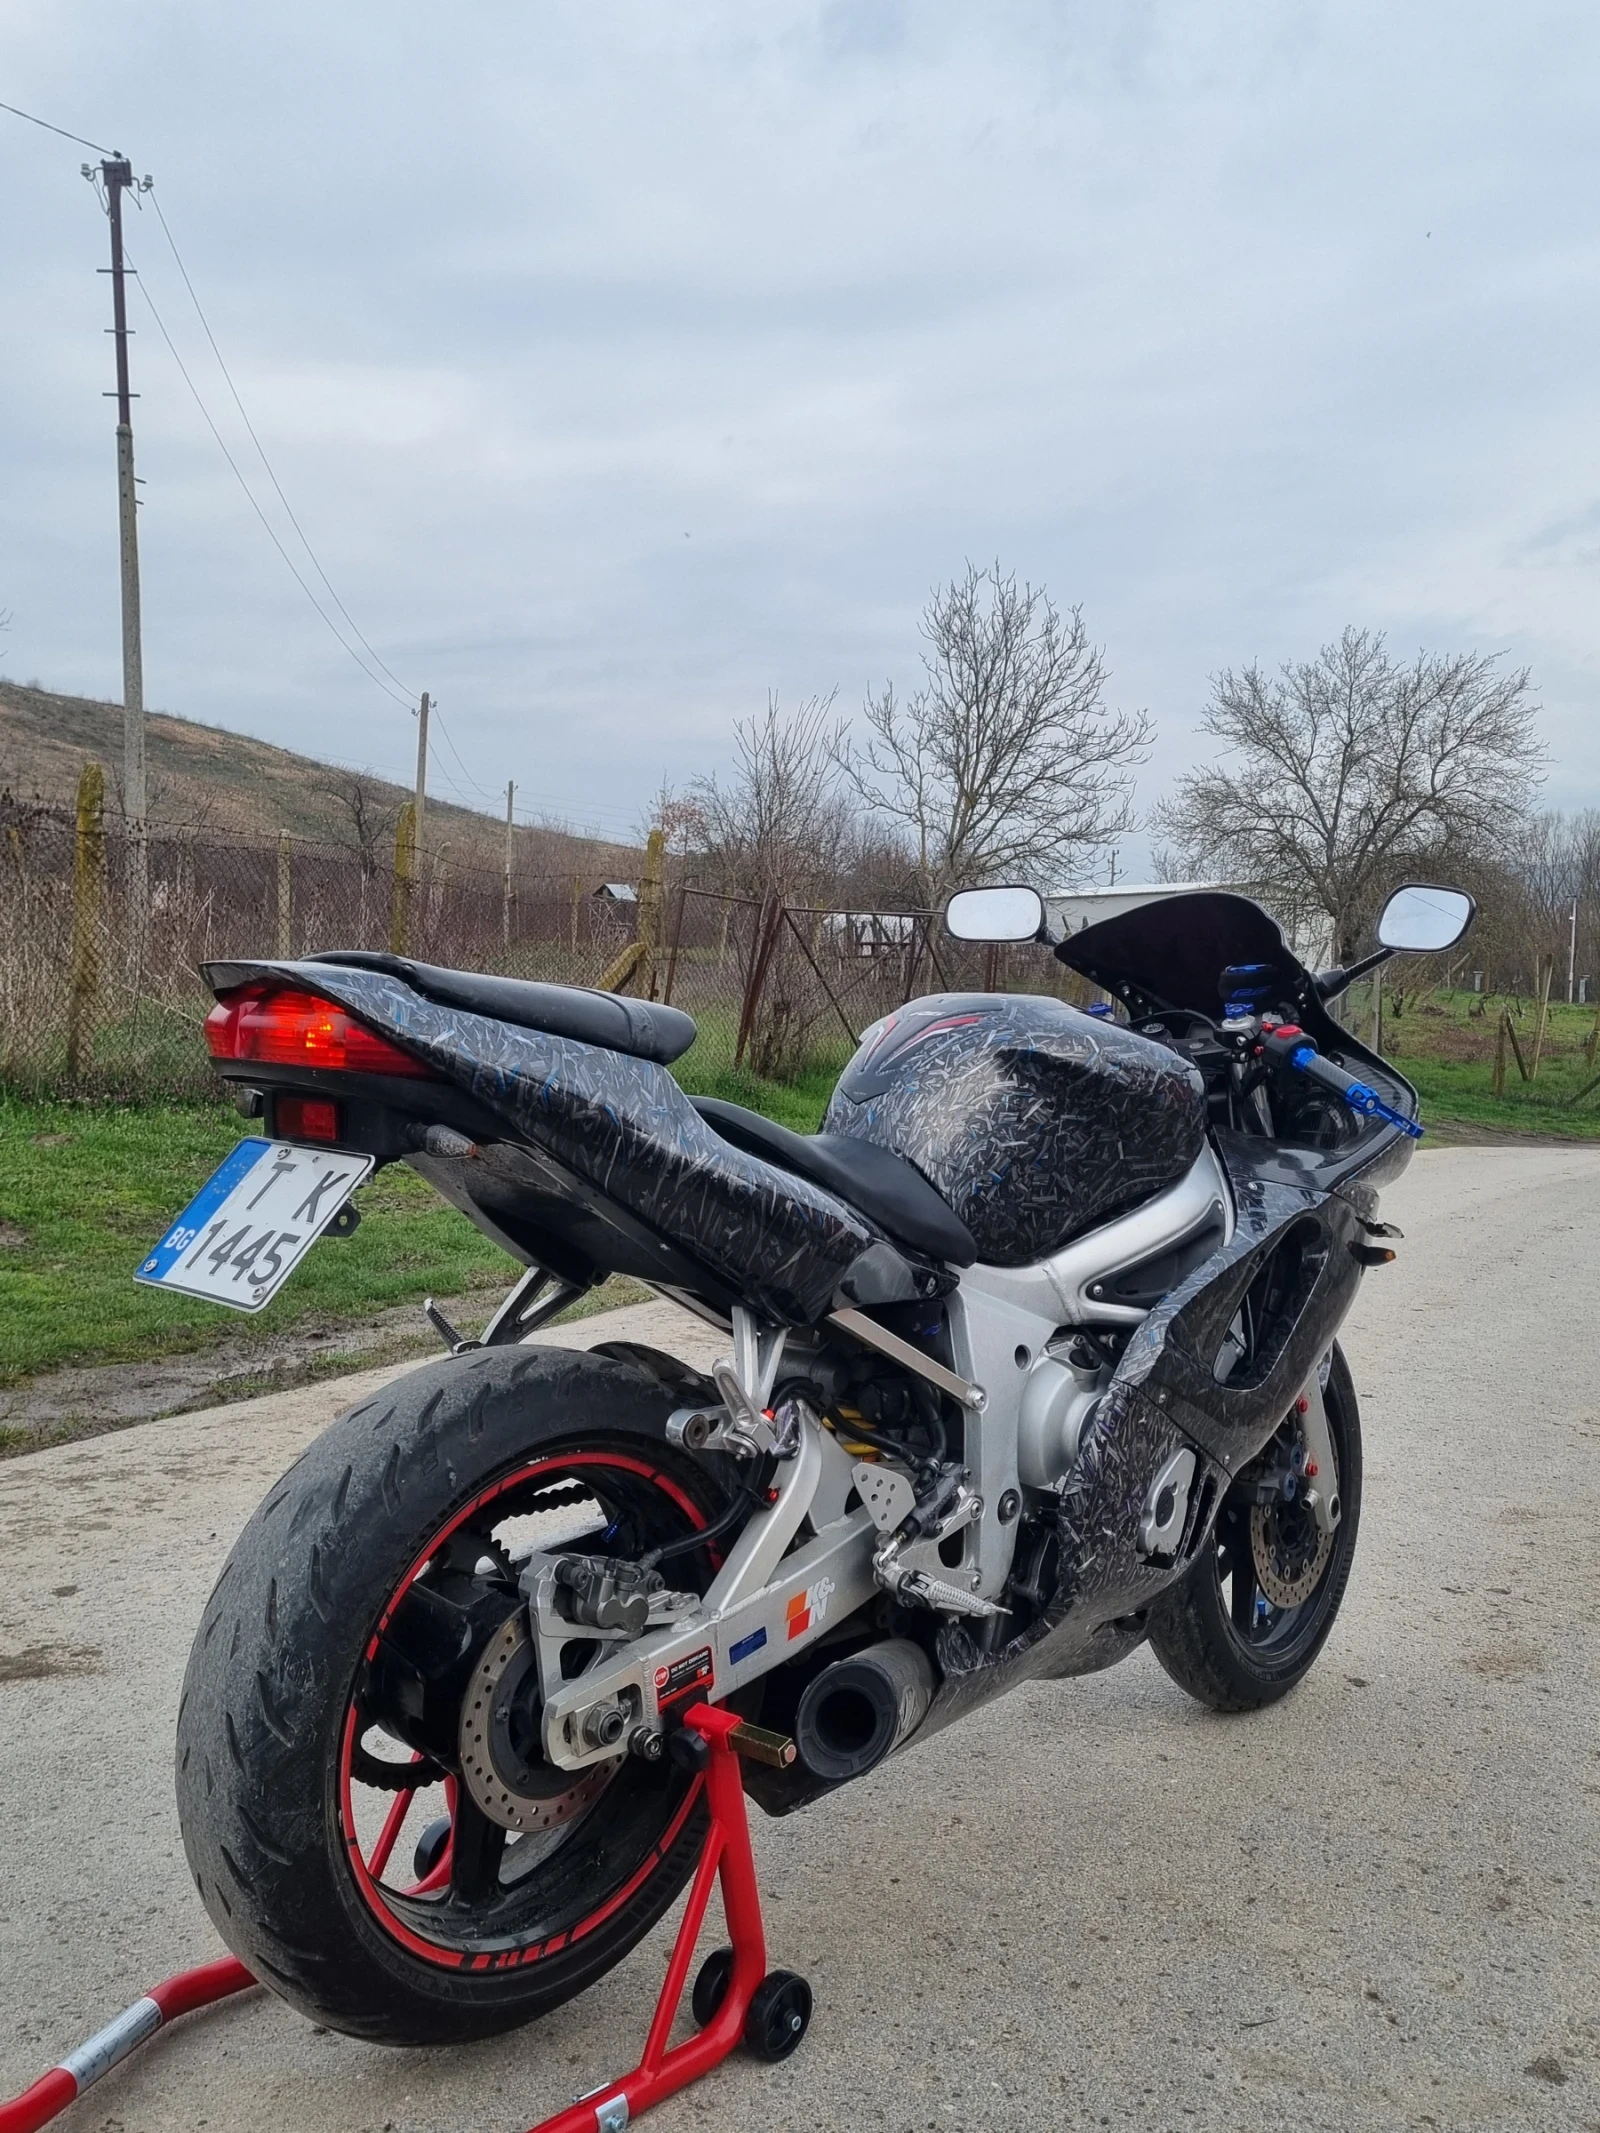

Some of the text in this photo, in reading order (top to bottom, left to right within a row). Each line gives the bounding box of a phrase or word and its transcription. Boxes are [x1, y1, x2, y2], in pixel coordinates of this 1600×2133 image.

[245, 1162, 350, 1224] T K
[164, 1226, 196, 1250] BG
[185, 1219, 301, 1286] 1445
[655, 1671, 667, 1683] STOP
